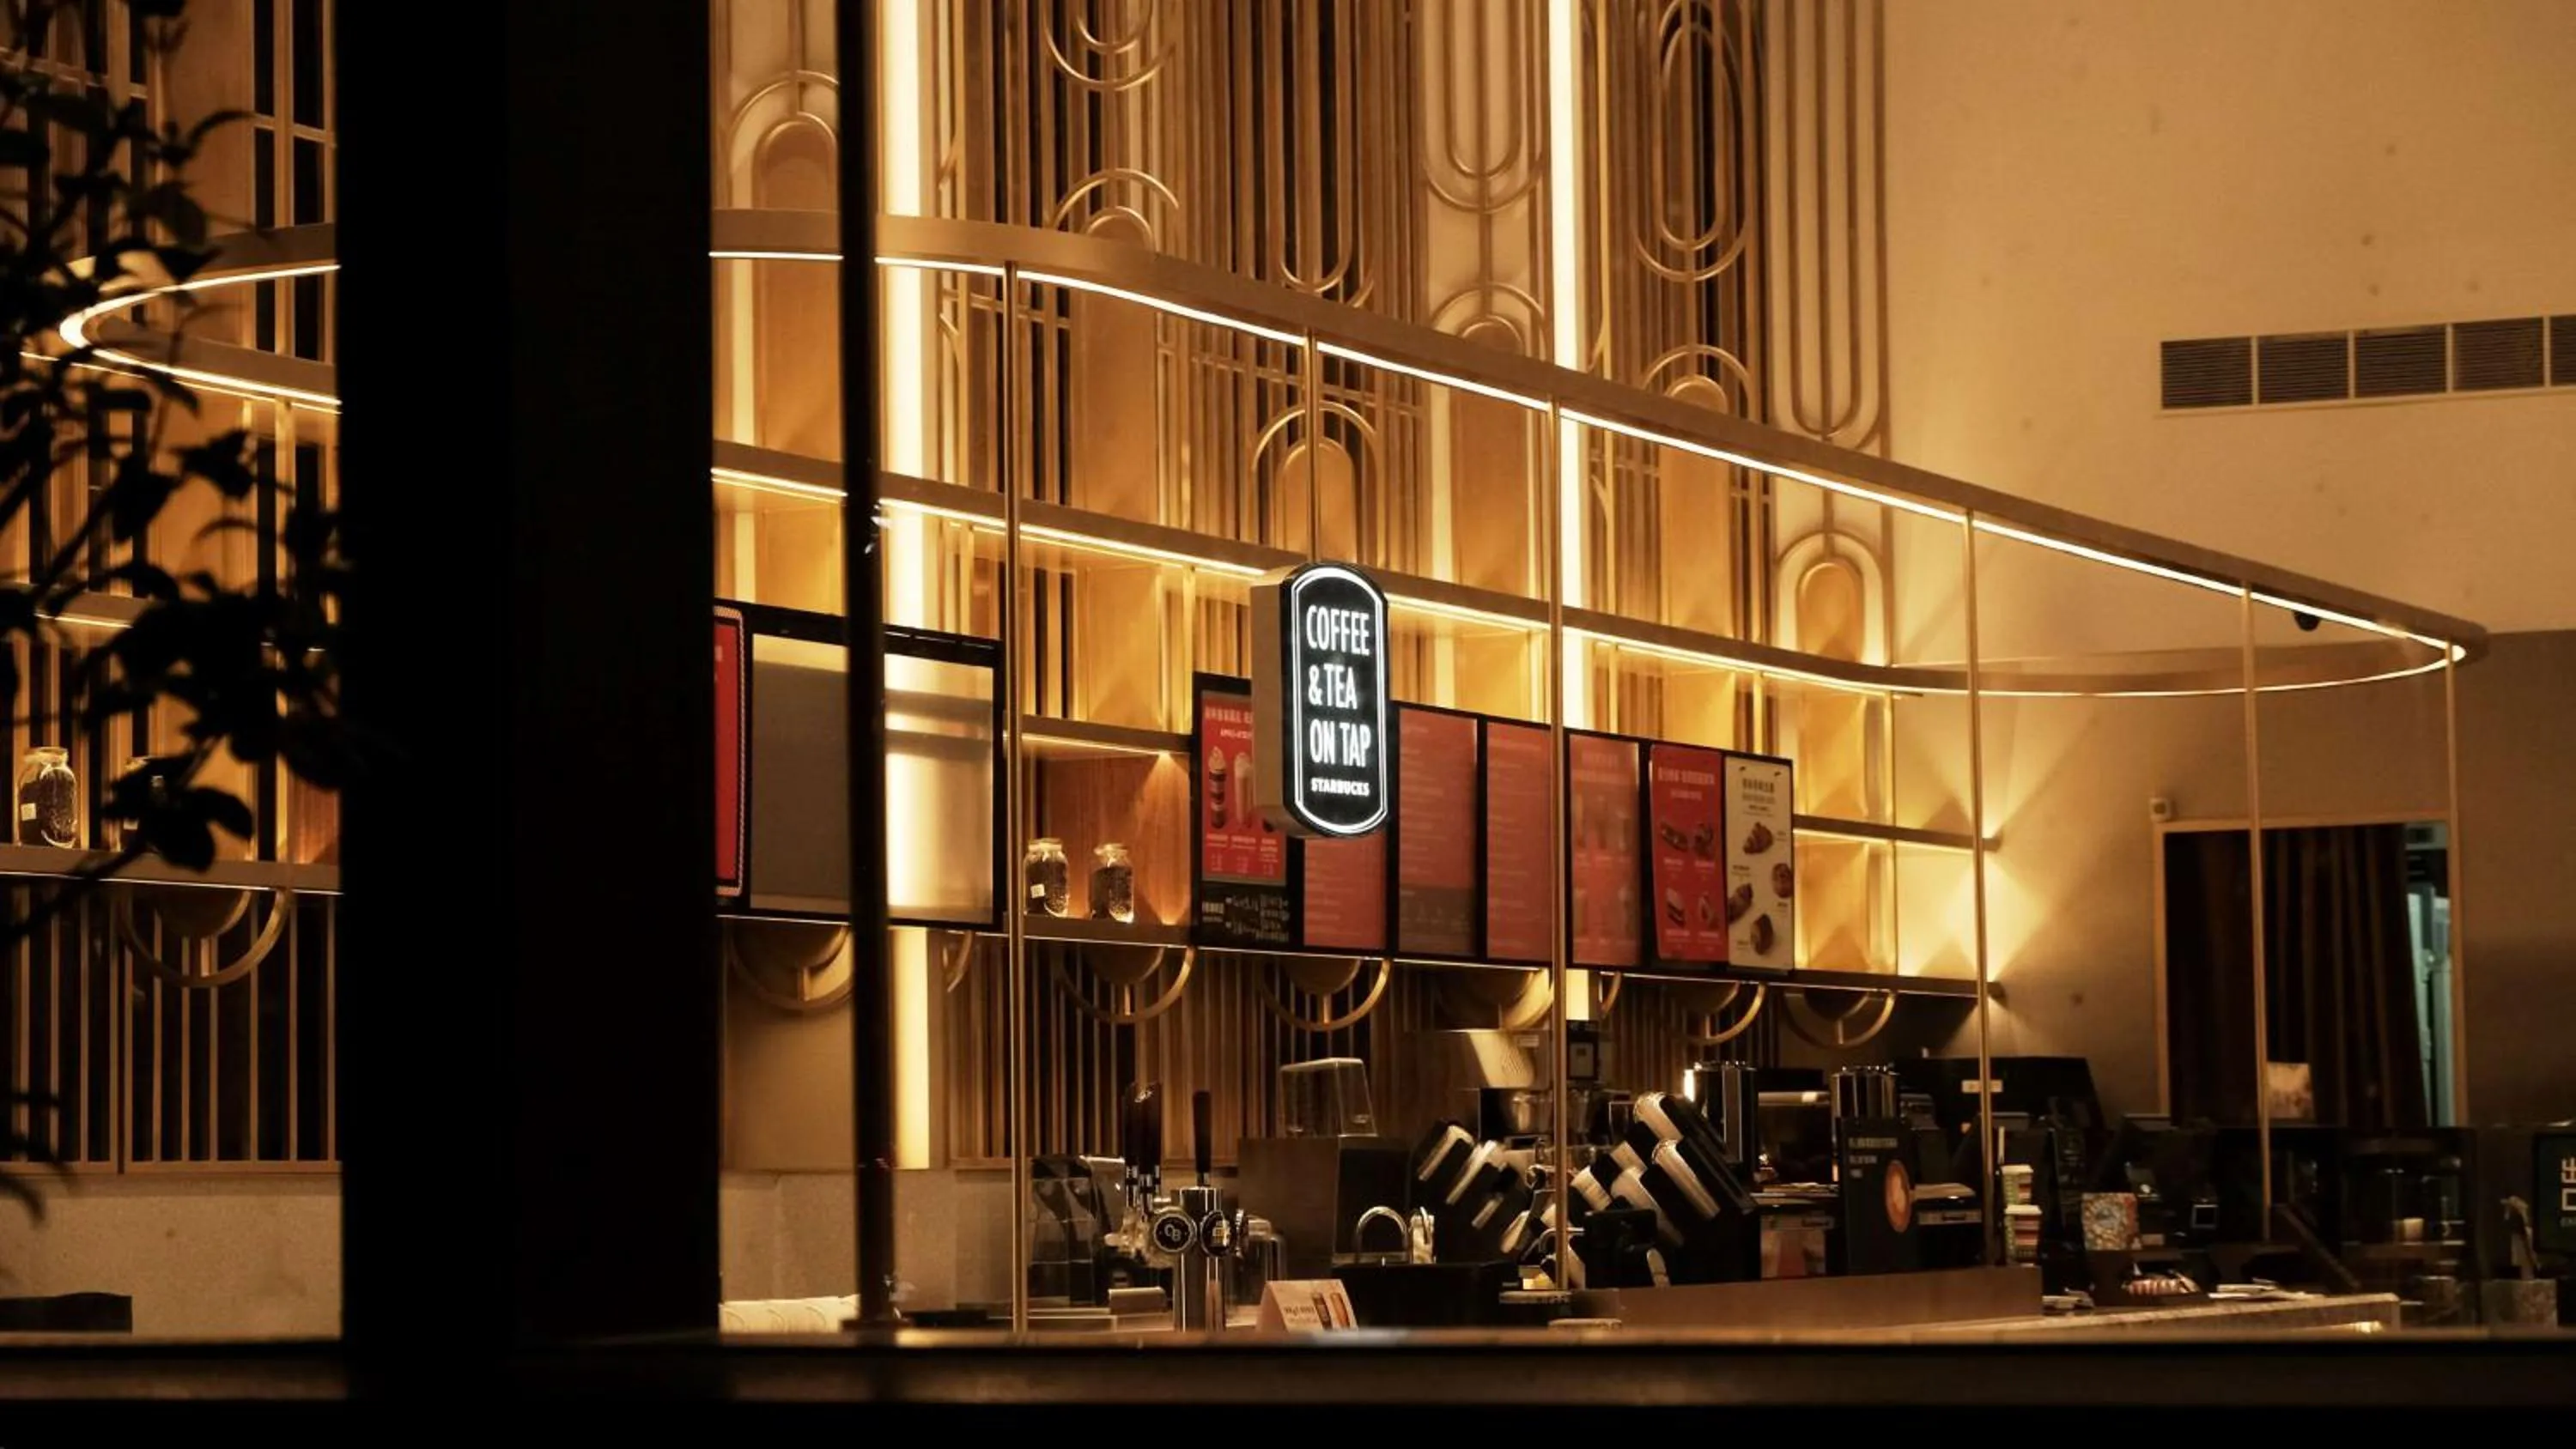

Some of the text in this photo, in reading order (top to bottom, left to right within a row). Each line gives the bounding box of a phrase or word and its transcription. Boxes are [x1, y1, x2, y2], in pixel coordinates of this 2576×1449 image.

[1306, 605, 1370, 655] COFFEE
[1308, 664, 1358, 709] & TEA
[1309, 718, 1371, 767] ON TAP
[1310, 778, 1370, 797] STARBUCKS
